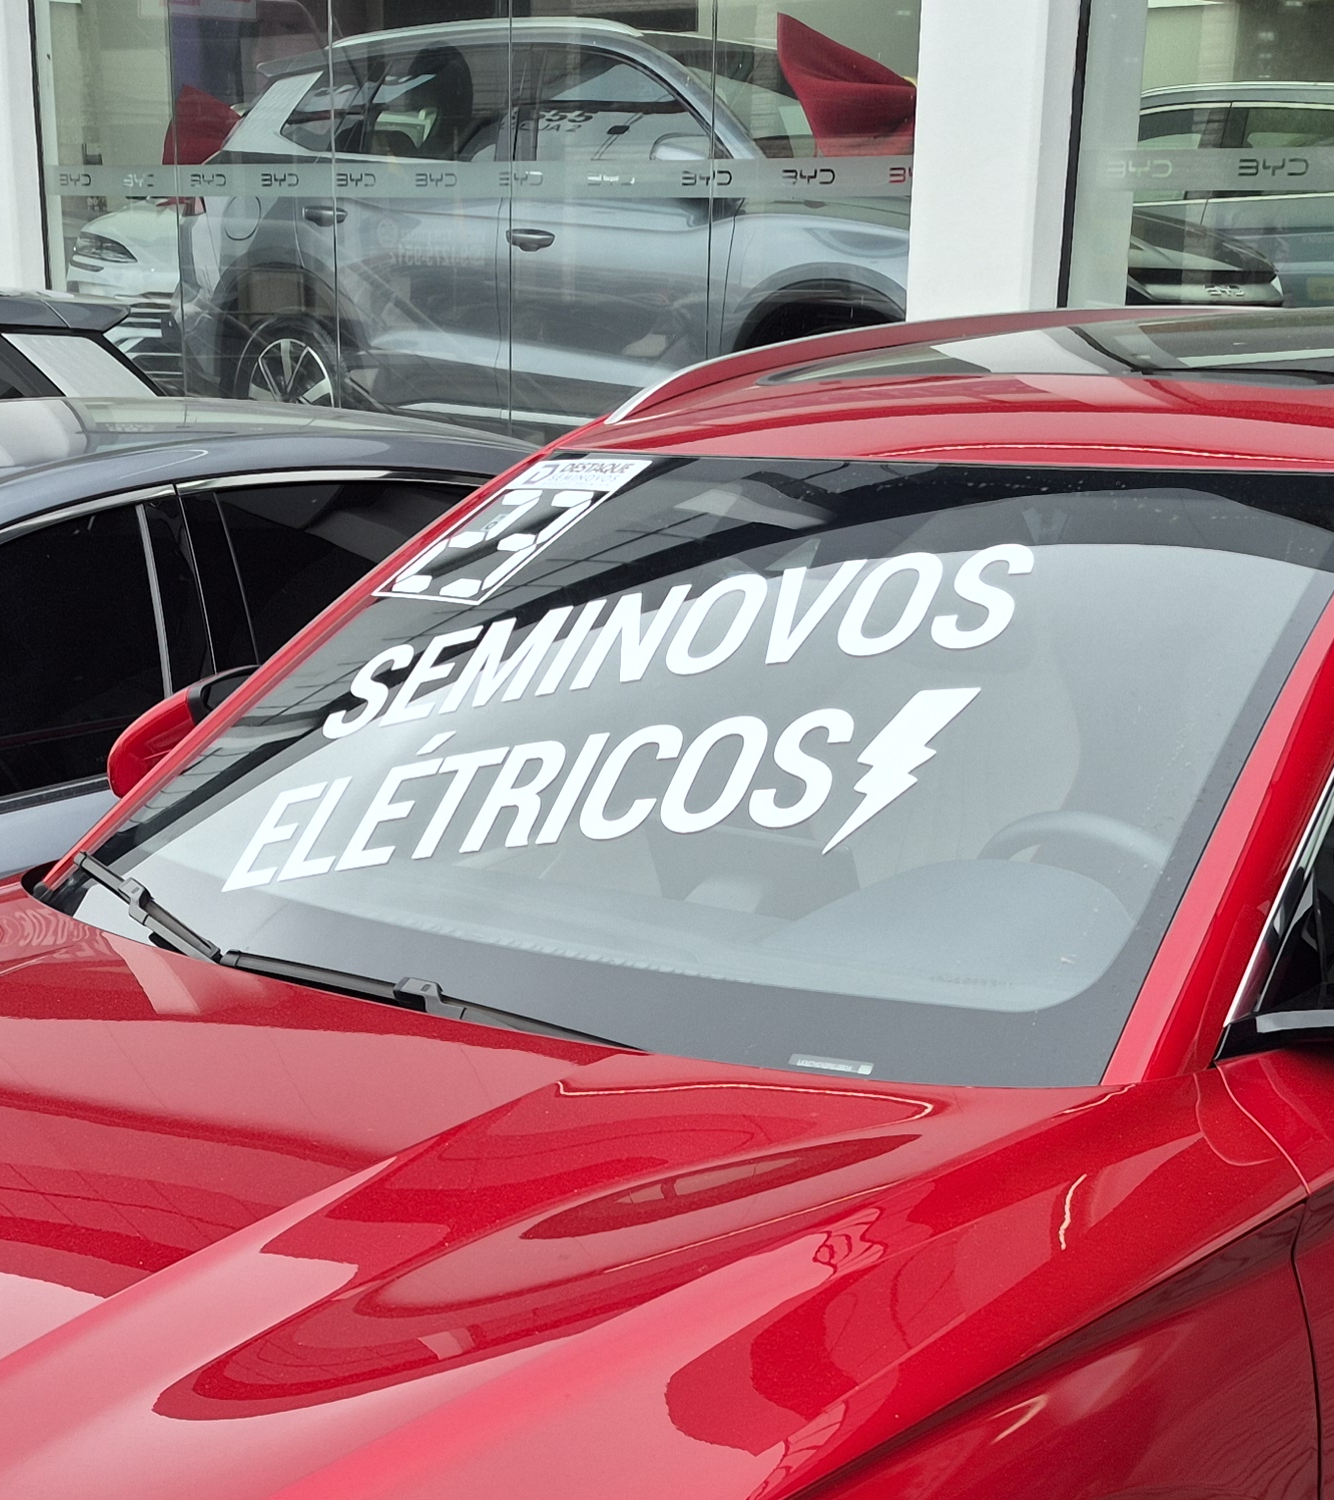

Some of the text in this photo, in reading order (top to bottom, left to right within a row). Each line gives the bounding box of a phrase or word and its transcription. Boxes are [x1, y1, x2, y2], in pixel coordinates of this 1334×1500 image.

[1107, 159, 1172, 178] BYD
[1237, 157, 1310, 177] BYD
[59, 173, 92, 188] BYD
[123, 172, 155, 188] BYD
[190, 173, 227, 188] BYD
[260, 172, 300, 188] BYD
[336, 172, 376, 188] BYD
[415, 172, 458, 188] BYD
[498, 171, 544, 187] BYD
[681, 170, 733, 186] BYD
[781, 168, 836, 186] BYD
[547, 473, 621, 483] SEMINOVOS
[560, 463, 635, 475] DESTAQUE
[321, 543, 1034, 741] SEMINOVOS
[221, 707, 856, 893] ELÉTRICOS
